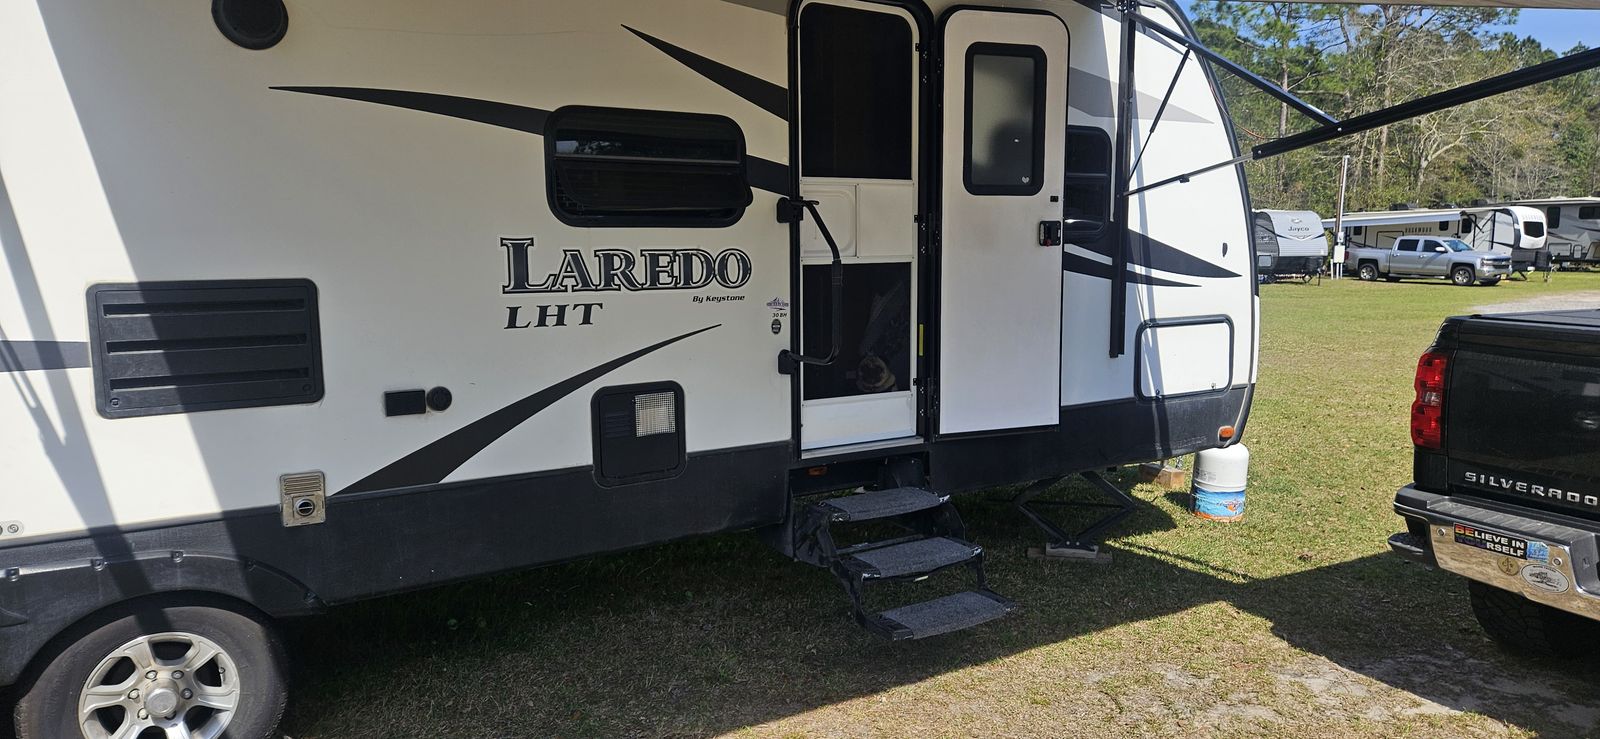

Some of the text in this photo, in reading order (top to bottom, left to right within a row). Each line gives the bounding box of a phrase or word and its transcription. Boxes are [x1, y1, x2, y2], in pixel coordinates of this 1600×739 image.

[500, 237, 752, 295] LAREDO
[692, 295, 746, 304] By Keystone
[503, 302, 604, 330] LHT
[1464, 471, 1598, 507] SILVERADO
[1455, 523, 1509, 545] BELIEVE
[1511, 540, 1525, 550] IN
